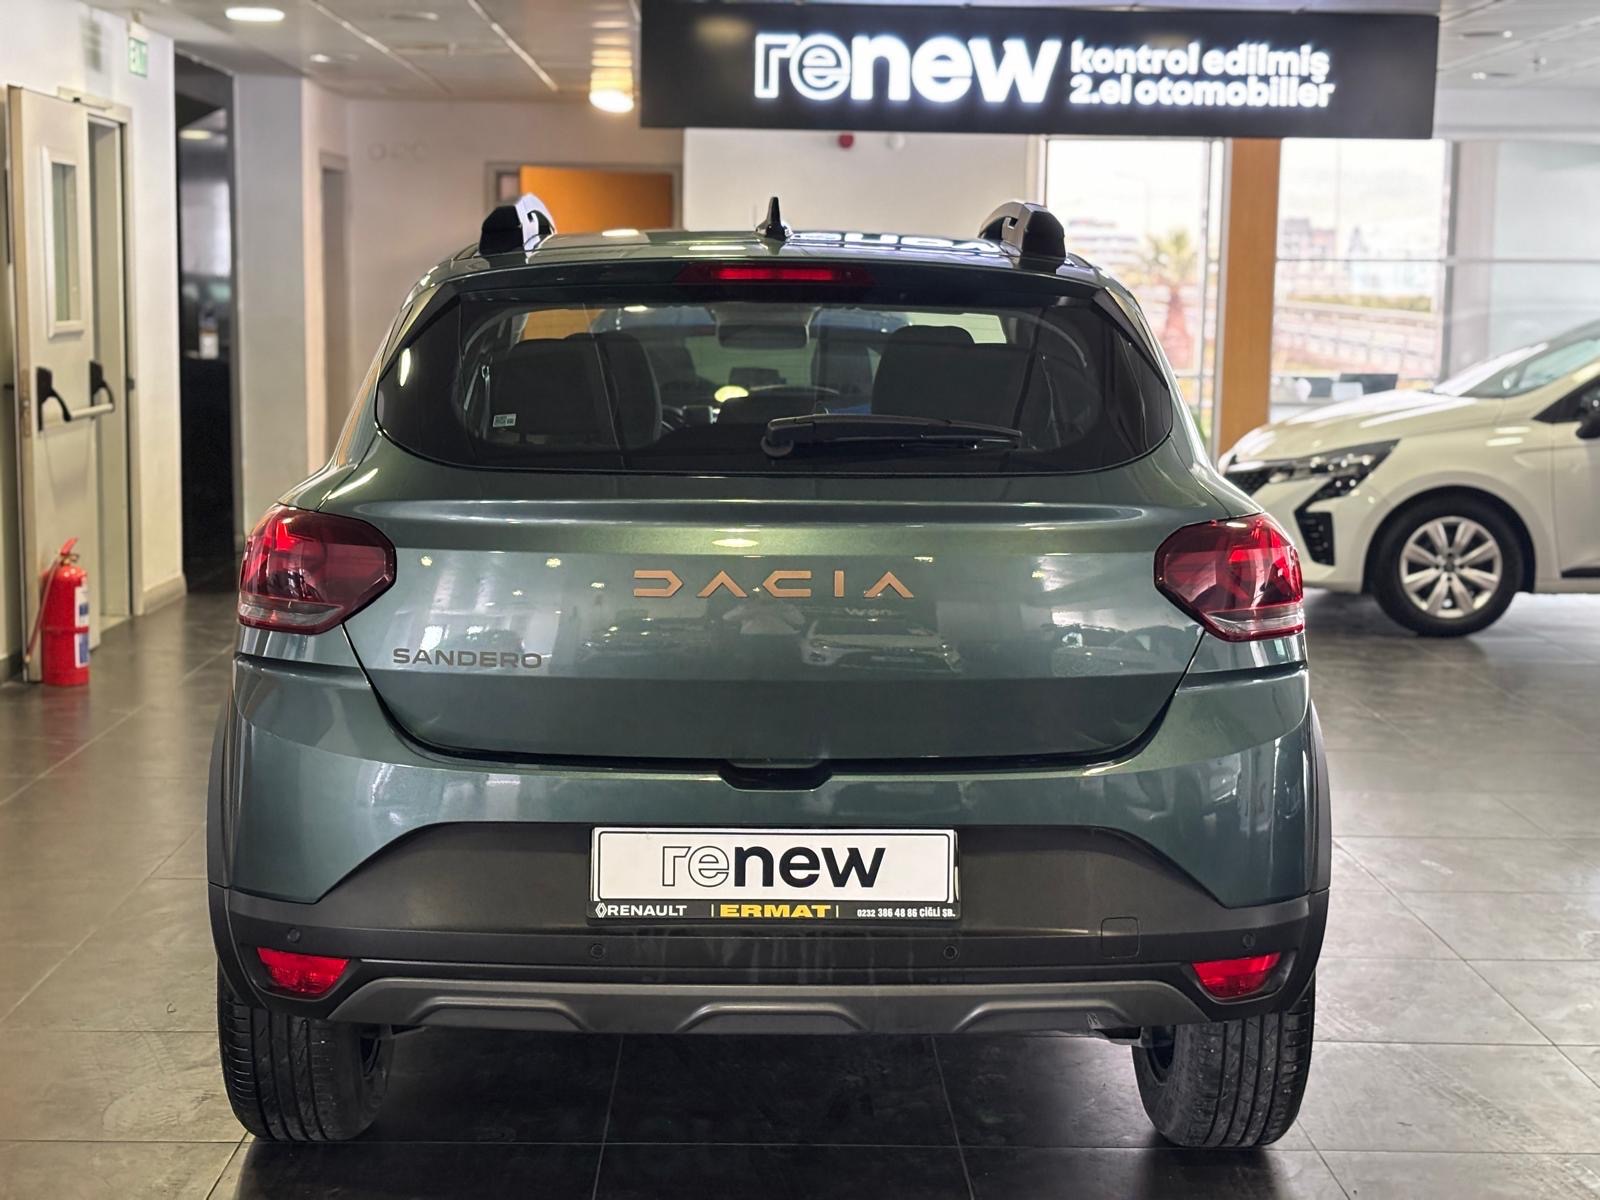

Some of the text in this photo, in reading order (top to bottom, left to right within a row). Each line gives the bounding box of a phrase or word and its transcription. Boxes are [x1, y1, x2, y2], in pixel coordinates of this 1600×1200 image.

[754, 33, 1062, 103] renew
[1070, 40, 1330, 83] kontrol edilmiş
[1069, 74, 1335, 108] 2.el otomobiller
[633, 569, 915, 599] DACIA
[393, 648, 542, 668] SANDERO
[661, 845, 886, 888] renew
[607, 904, 687, 916] RENAULT
[720, 904, 831, 918] ERMAT
[857, 909, 876, 917] 0232
[877, 908, 893, 917] 386
[894, 908, 906, 917] 48
